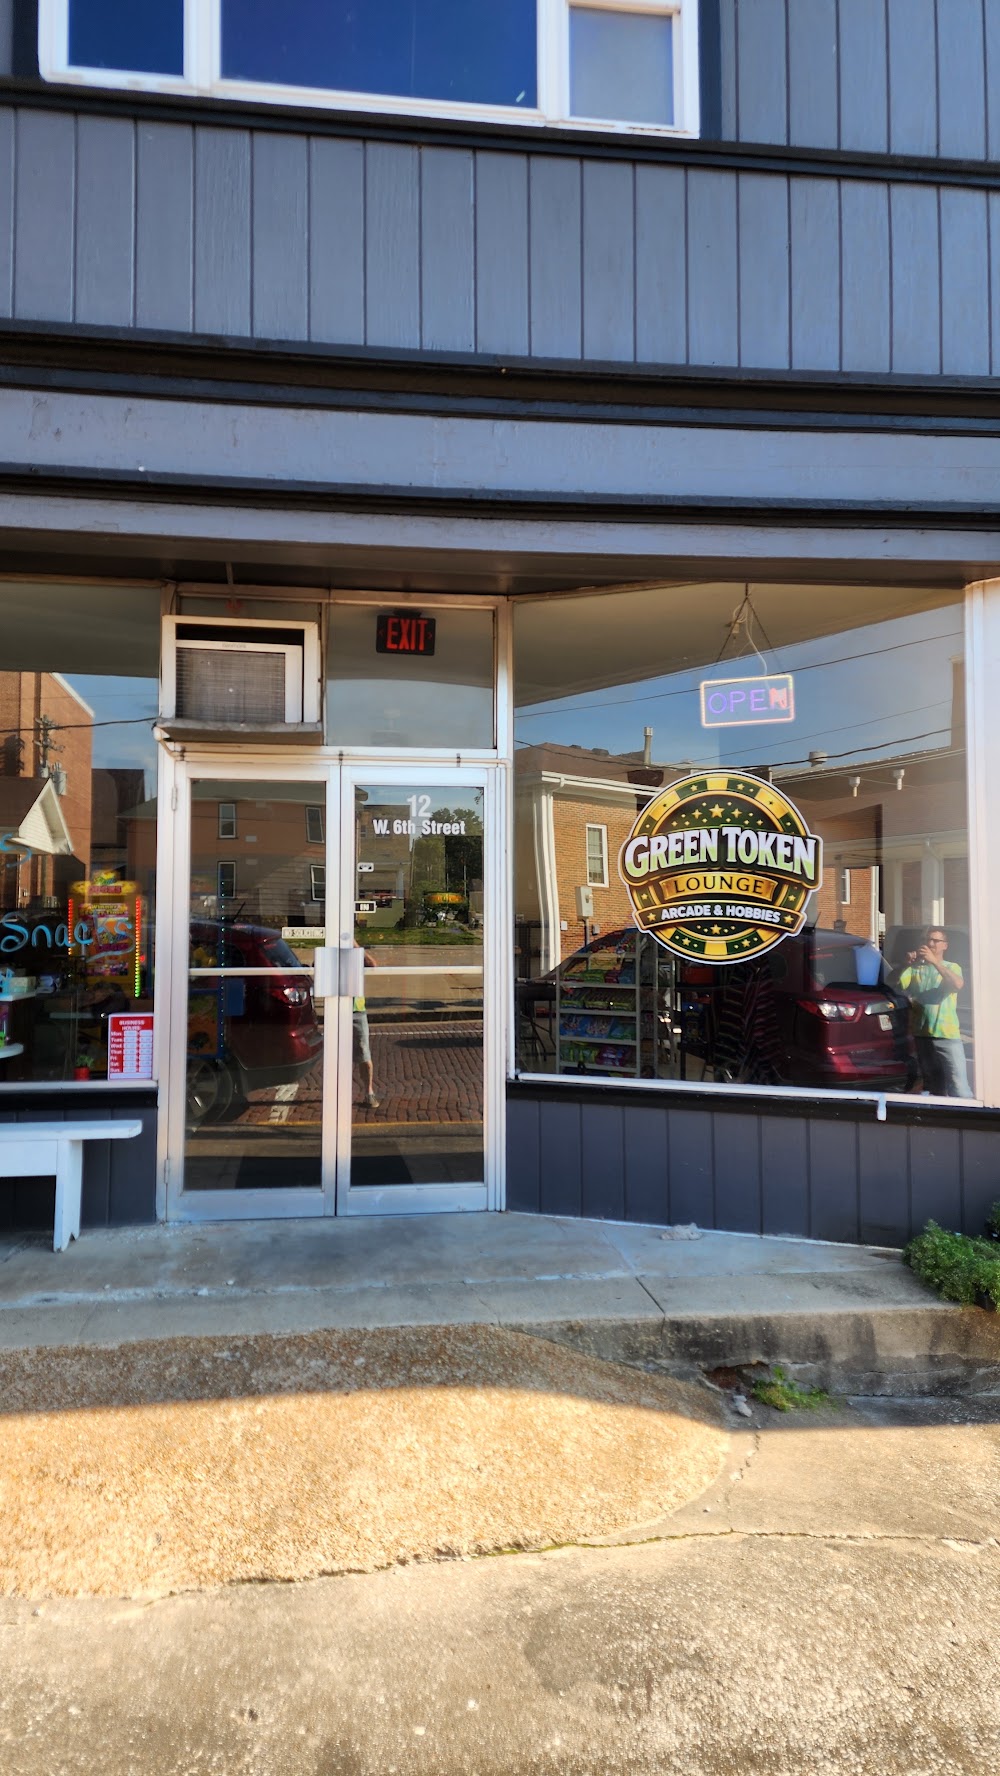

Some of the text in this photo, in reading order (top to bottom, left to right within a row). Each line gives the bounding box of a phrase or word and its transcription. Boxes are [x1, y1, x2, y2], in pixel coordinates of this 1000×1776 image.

[386, 617, 428, 651] EXIT
[708, 687, 788, 714] OPEN
[406, 794, 432, 817] 12
[372, 819, 466, 835] W. 6th Street
[624, 826, 816, 881] GREEN TOKEN
[674, 876, 764, 895] LOUNGE
[661, 904, 781, 923] ARCADE & HOBBIES
[0, 911, 136, 963] Snacks
